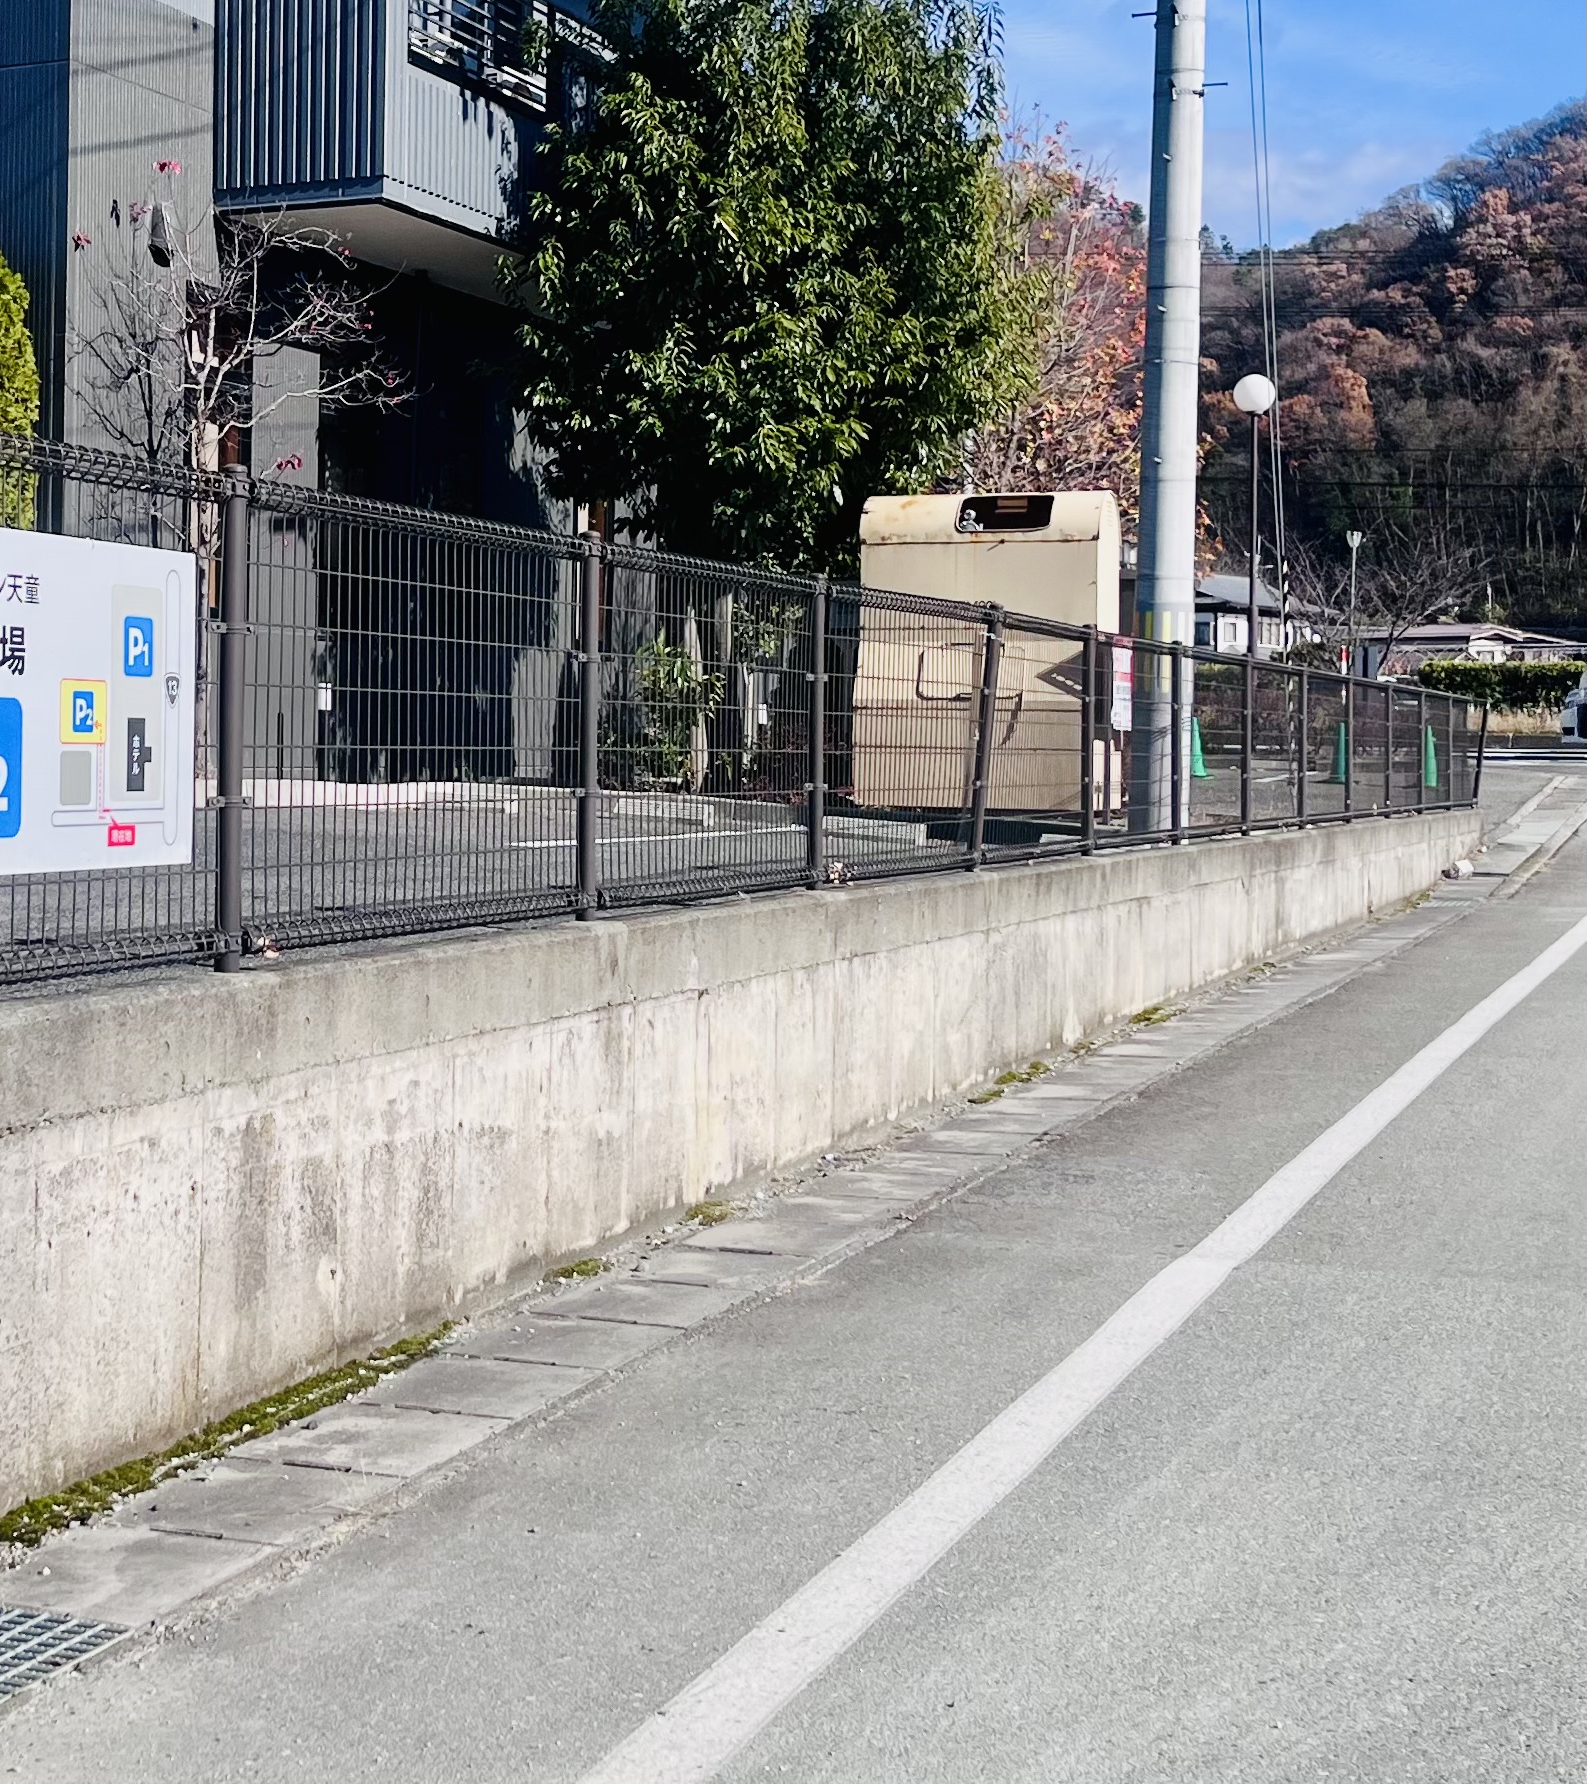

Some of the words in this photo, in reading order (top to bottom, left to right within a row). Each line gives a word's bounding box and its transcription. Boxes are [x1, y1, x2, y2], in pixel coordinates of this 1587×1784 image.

[128, 627, 149, 666] P1
[167, 680, 178, 696] 13
[75, 698, 94, 727] P2
[131, 734, 141, 775] ホテル
